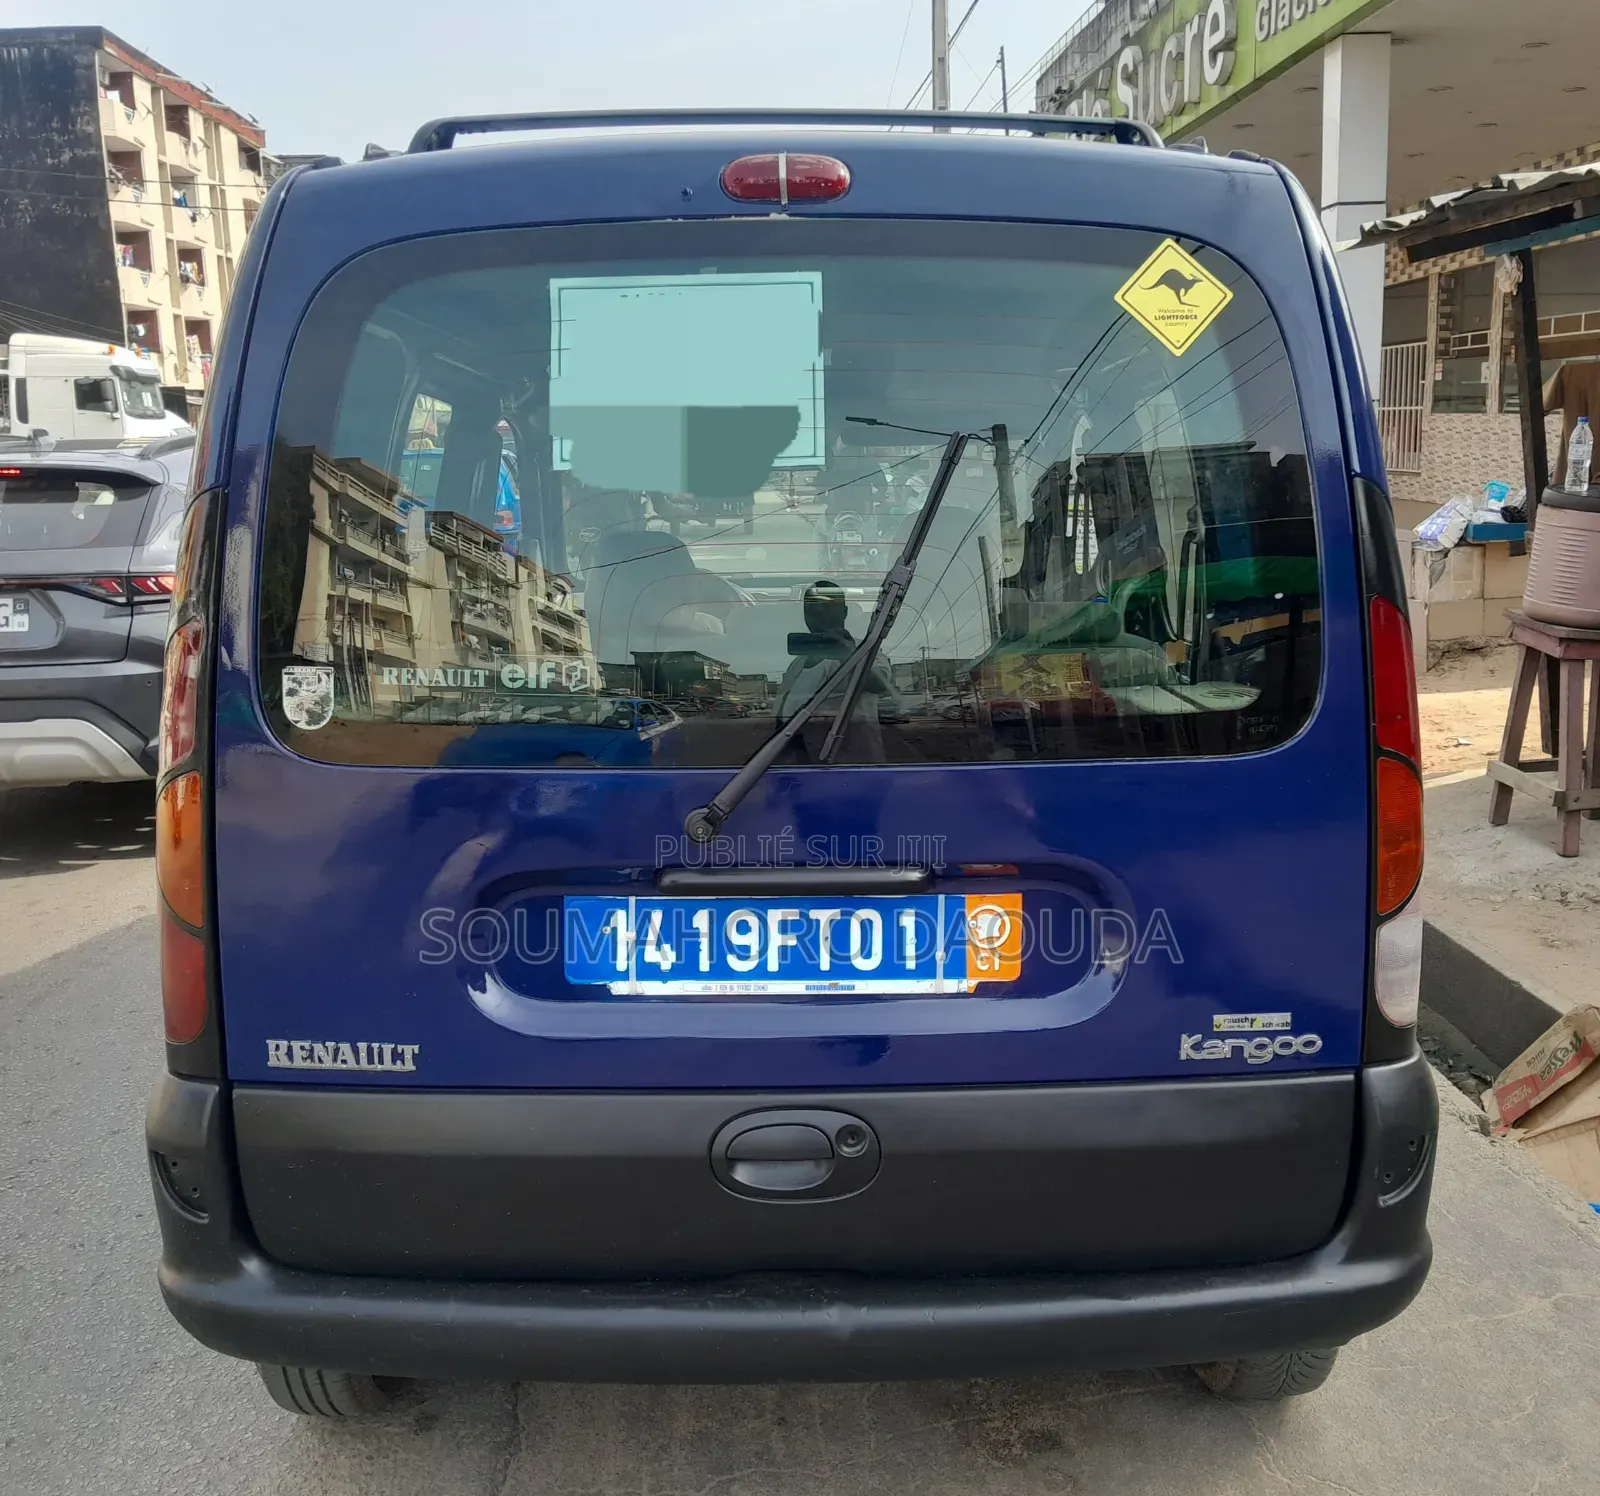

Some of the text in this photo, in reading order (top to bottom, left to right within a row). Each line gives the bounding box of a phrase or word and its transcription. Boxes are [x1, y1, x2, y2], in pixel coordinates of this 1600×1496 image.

[381, 666, 489, 688] RENAULT
[500, 661, 556, 689] elf
[266, 1039, 420, 1072] RENAULT
[1180, 1033, 1323, 1064] Kangoo
